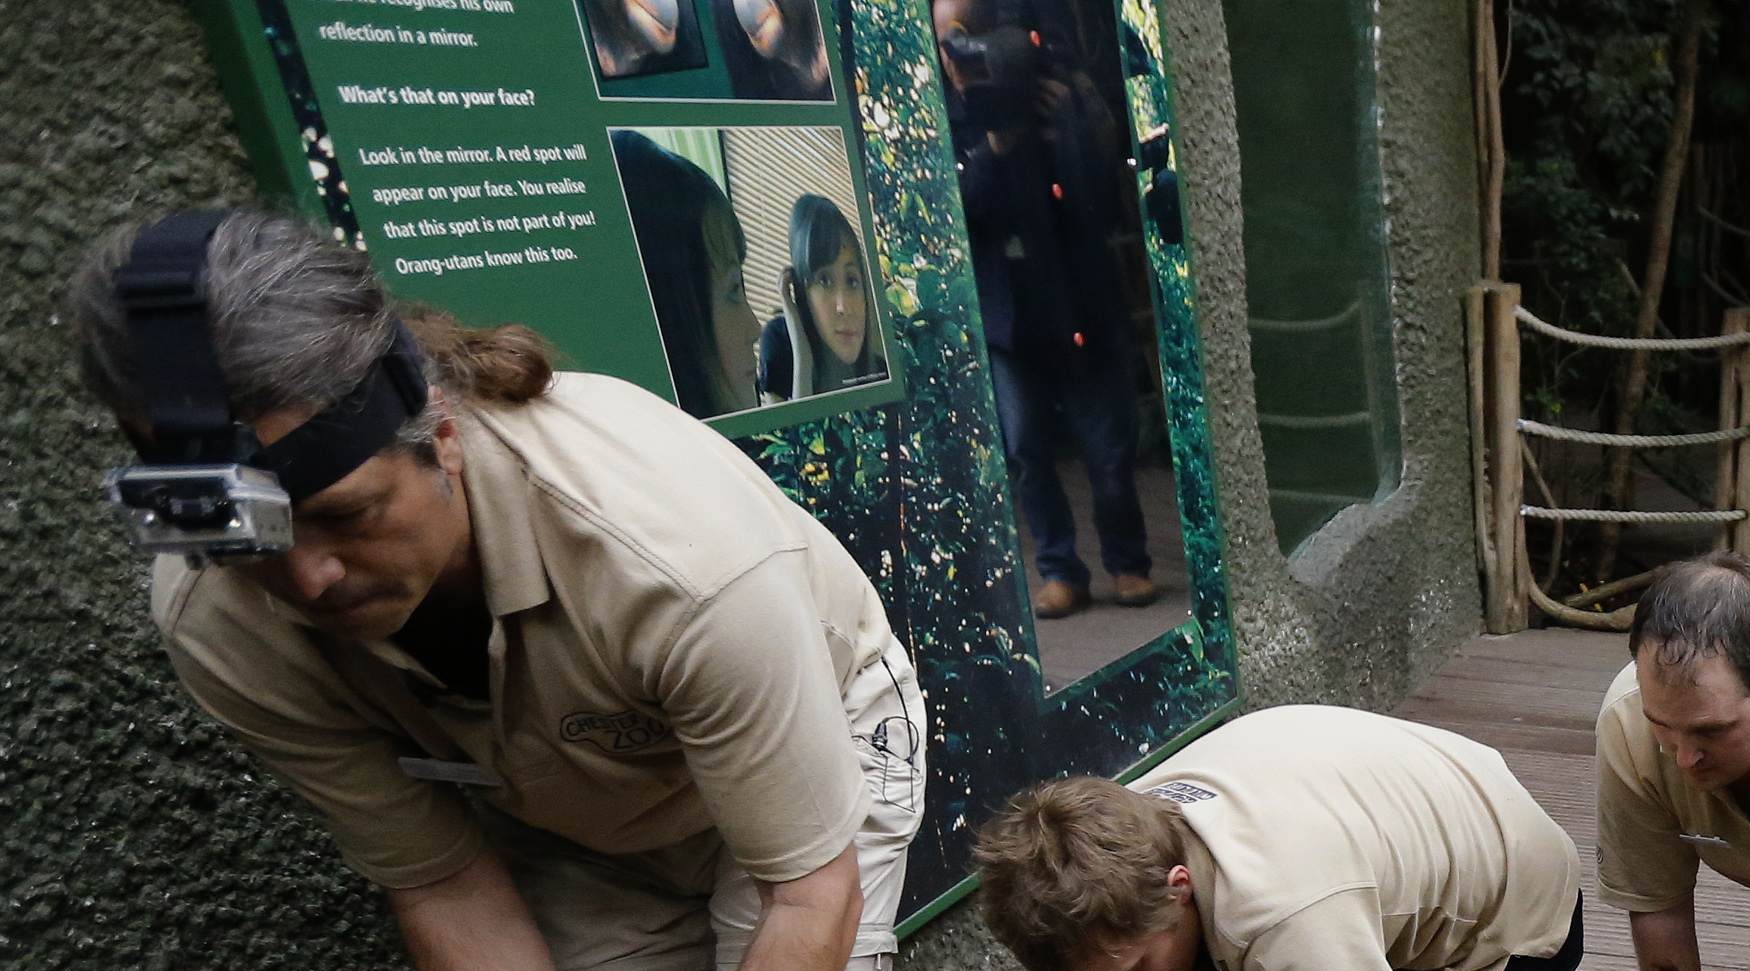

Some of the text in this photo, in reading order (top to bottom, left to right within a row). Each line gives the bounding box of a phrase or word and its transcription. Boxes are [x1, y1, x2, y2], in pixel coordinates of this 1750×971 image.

[482, 0, 515, 13] own
[319, 21, 478, 47] reflection in a mirror.
[337, 85, 535, 109] What's that on your face?
[358, 143, 588, 165] Look in the mirror. A red spot will
[372, 177, 586, 206] appear on your face. You realise
[383, 210, 596, 239] that this spot is not part of you!
[395, 246, 578, 276] Orang-utans know this too.
